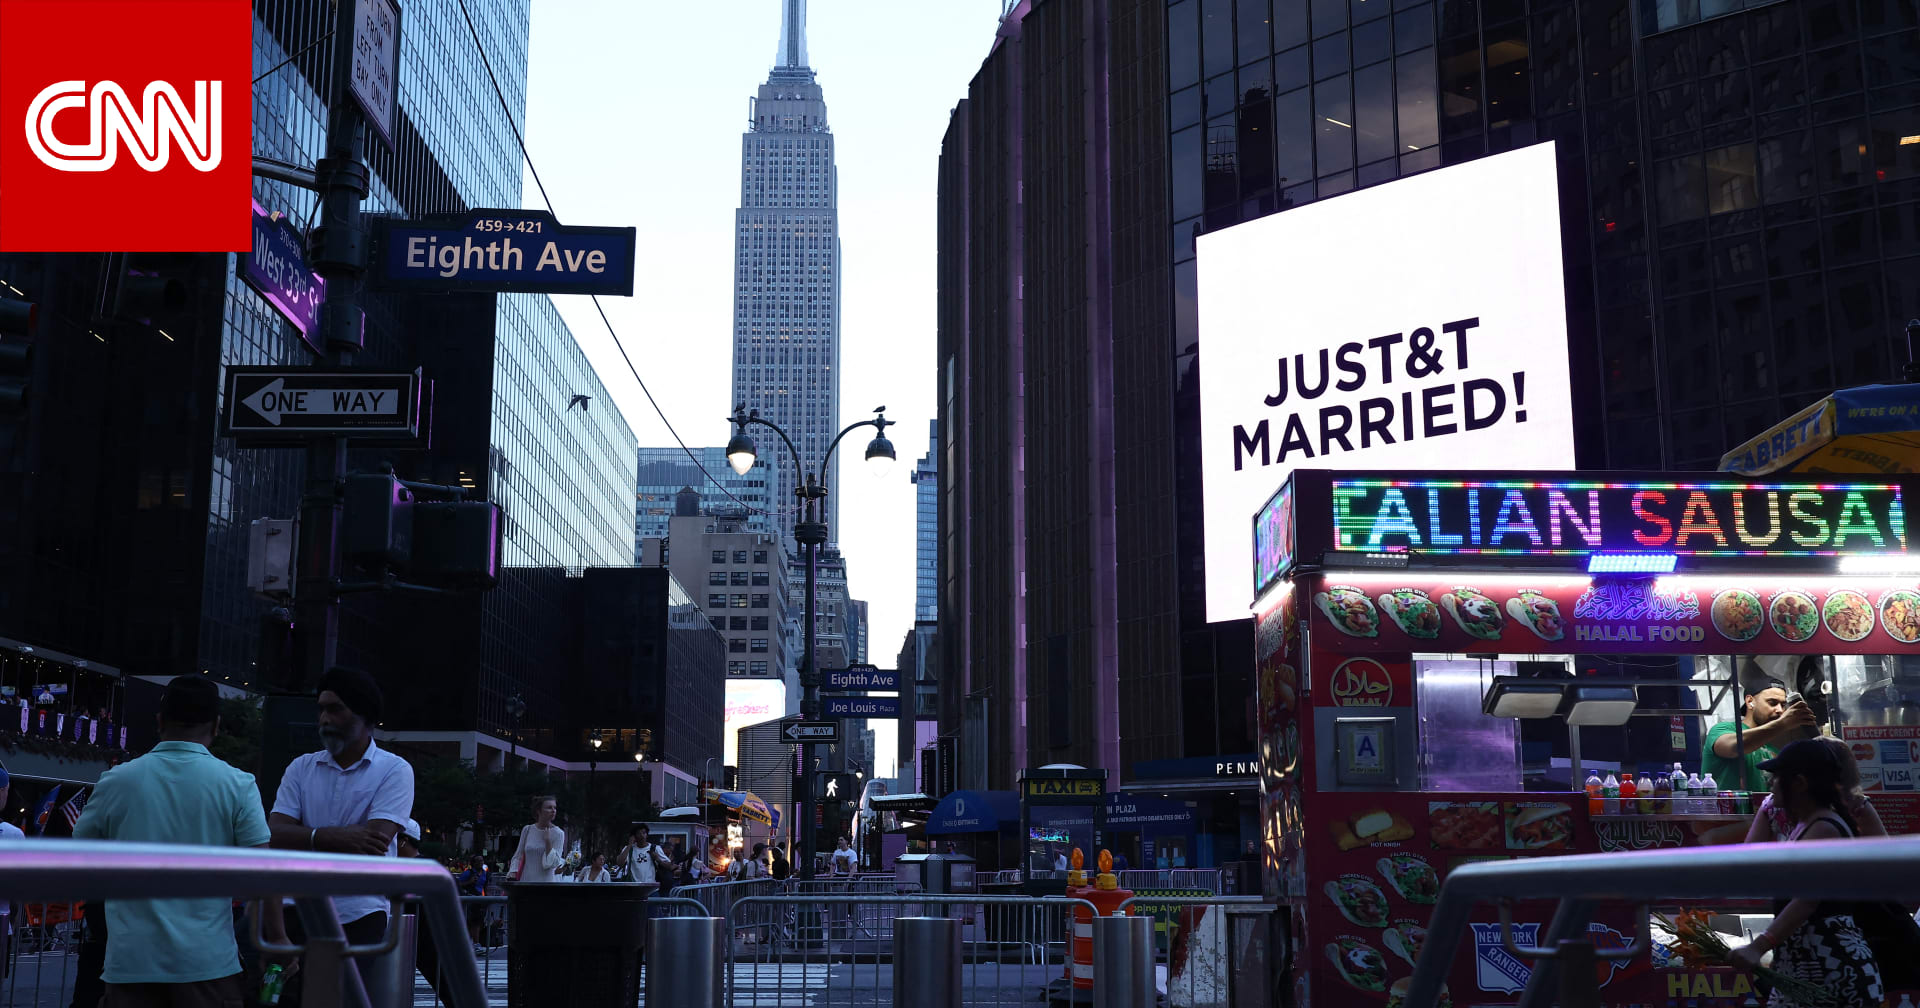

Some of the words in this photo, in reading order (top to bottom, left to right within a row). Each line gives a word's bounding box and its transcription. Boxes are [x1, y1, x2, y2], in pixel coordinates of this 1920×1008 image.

[377, 2, 392, 38] TURN
[366, 15, 383, 54] FROM
[356, 28, 372, 64] LEFT
[374, 55, 389, 92] TURN
[356, 59, 369, 90] BAY
[371, 81, 386, 115] ONLY
[475, 219, 503, 232] 459
[515, 220, 543, 233] 421
[406, 235, 524, 278] Eighth
[535, 241, 607, 274] Ave
[255, 226, 285, 290] West
[285, 261, 307, 304] 33rd
[307, 286, 319, 326] St
[1263, 316, 1480, 407] JUST&T
[261, 391, 308, 412] ONE
[332, 391, 384, 412] WAY
[1888, 406, 1906, 416] ON
[1232, 370, 1528, 472] MARRIED!
[1414, 590, 1429, 599] GYRO
[1574, 625, 1644, 641] HALAL
[1647, 626, 1705, 642] FOOD
[831, 673, 868, 688] Eighth
[871, 674, 894, 685] Ave
[1335, 666, 1389, 697] حلال
[831, 702, 848, 713] Joe
[850, 701, 877, 713] Louis
[1343, 697, 1382, 707] HALAL
[790, 727, 806, 735] ONE
[812, 727, 829, 735] WAY
[1846, 728, 1857, 738] WE
[1860, 727, 1888, 738] ACCEPT
[1357, 735, 1377, 757] A
[1216, 761, 1259, 775] PENN
[1886, 770, 1911, 782] VISA
[1035, 781, 1076, 794] TAXI
[955, 798, 965, 816] D
[1115, 804, 1137, 814] PLAZA
[1479, 931, 1502, 944] NEW
[1510, 931, 1534, 945] ORK
[1667, 973, 1764, 998] HALA
